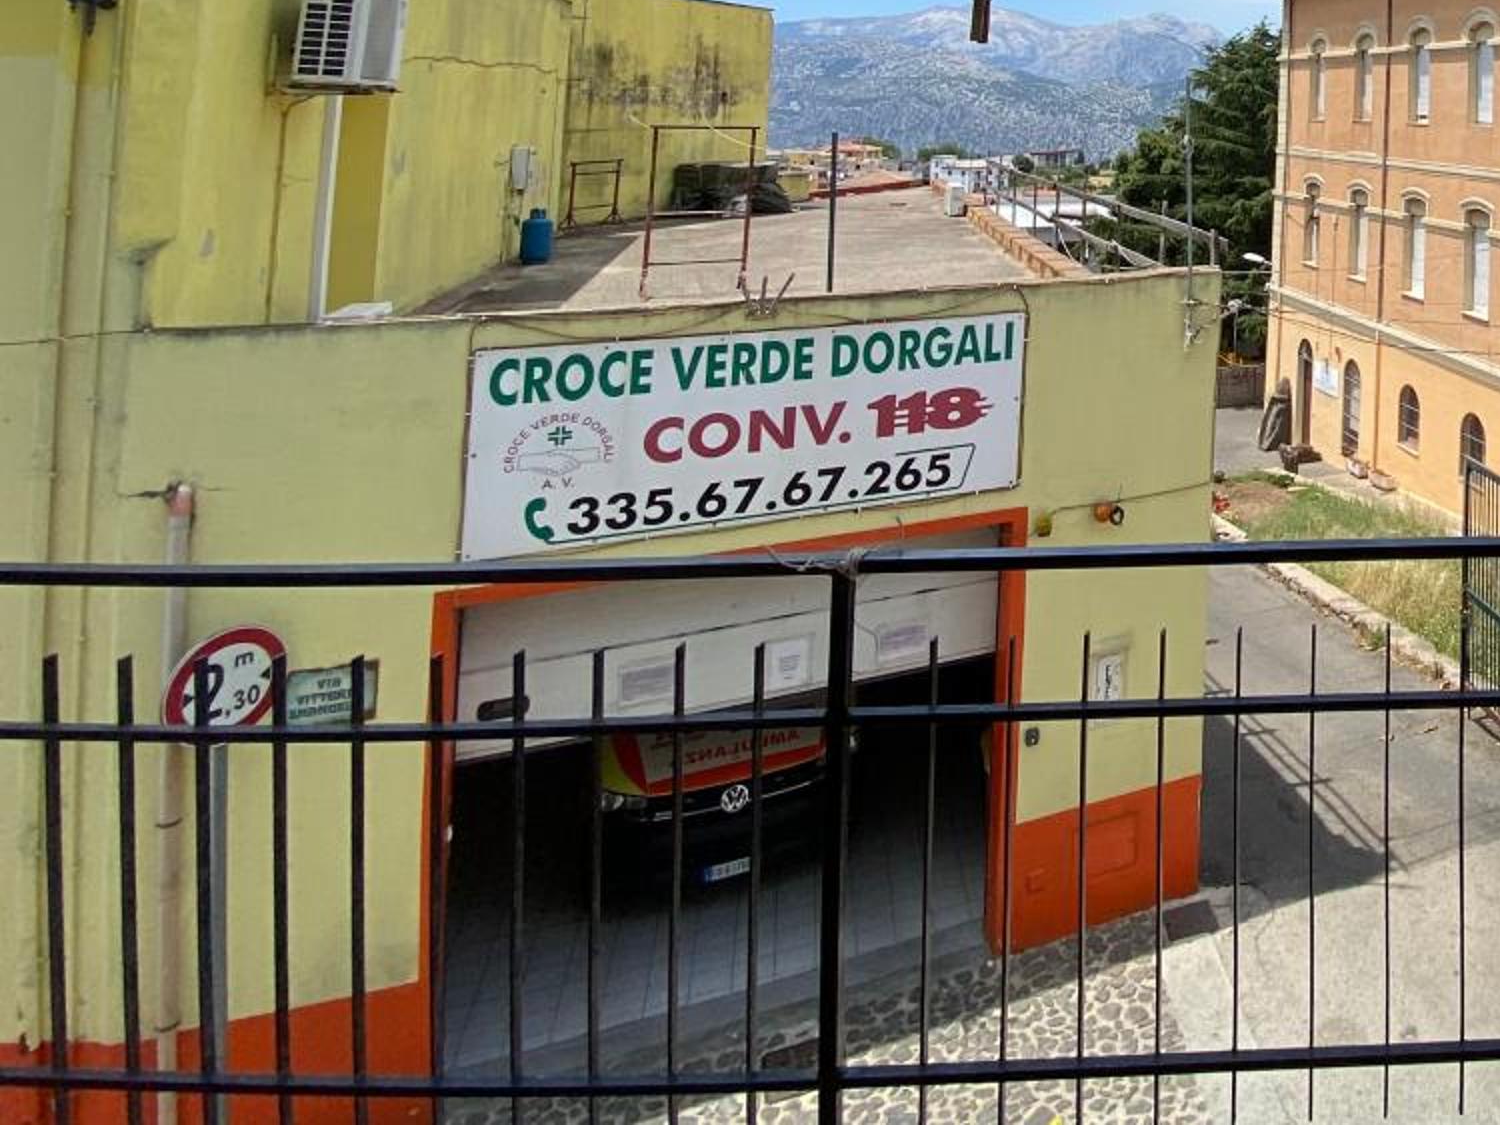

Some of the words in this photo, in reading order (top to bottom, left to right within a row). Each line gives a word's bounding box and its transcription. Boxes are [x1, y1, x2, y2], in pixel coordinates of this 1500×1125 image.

[488, 349, 654, 406] CROCE
[671, 338, 815, 391] VERDE
[831, 322, 1014, 378] DORGALI
[502, 429, 530, 474] CROCE
[529, 412, 581, 431] VERDE
[643, 403, 850, 463] CONV.
[867, 386, 994, 439] 118
[566, 452, 952, 535] 335.67.67.265
[233, 651, 255, 668] m
